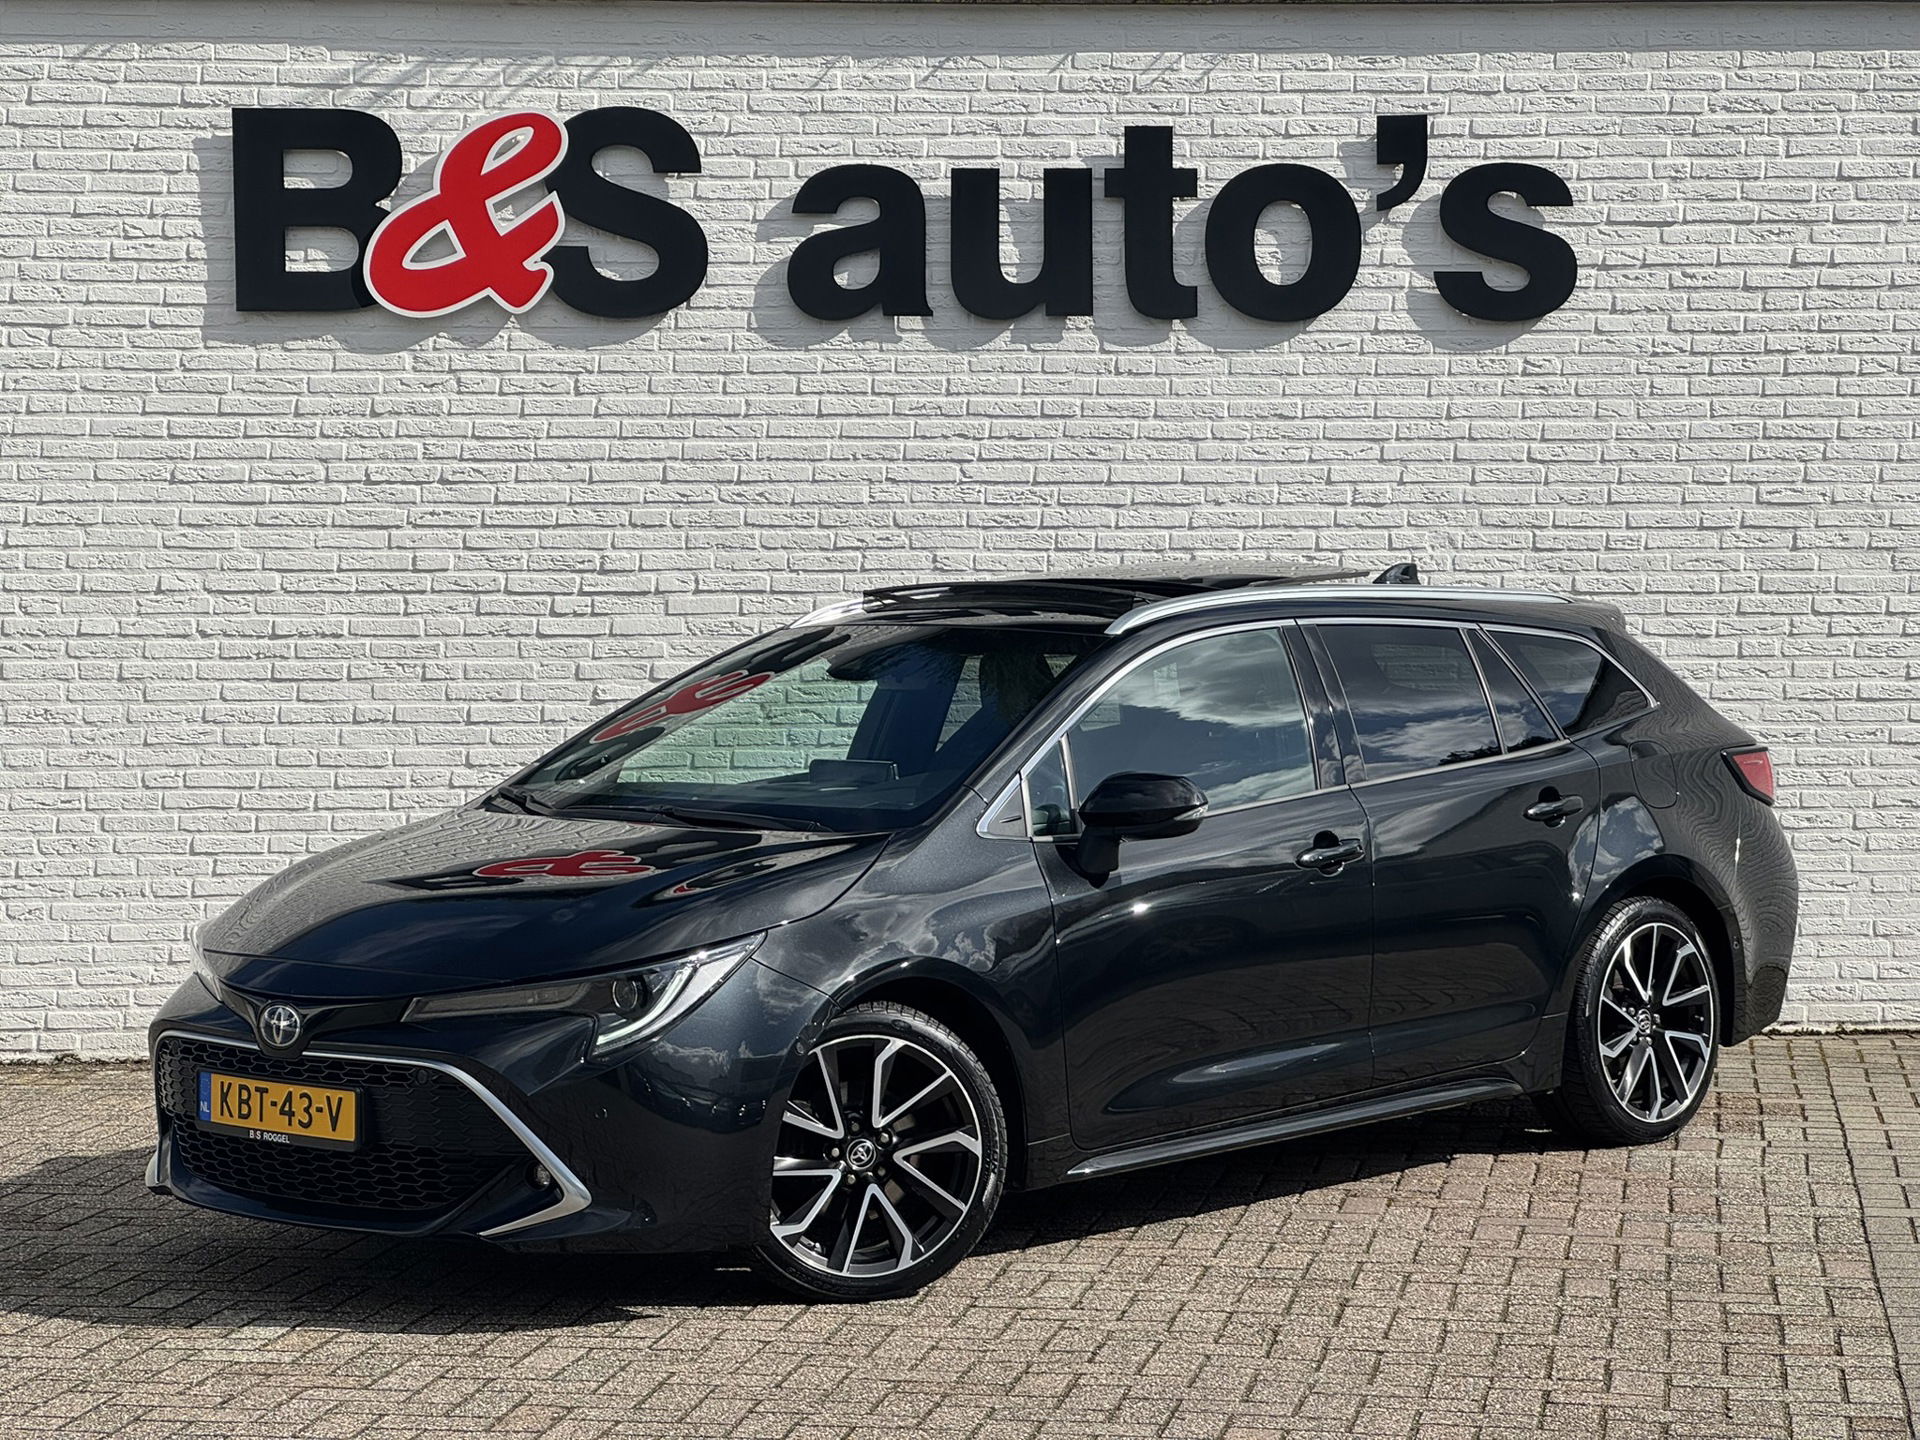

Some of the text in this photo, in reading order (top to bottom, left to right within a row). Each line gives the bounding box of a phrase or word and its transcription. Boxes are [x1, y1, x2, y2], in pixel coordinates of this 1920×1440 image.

[232, 106, 1578, 323] B&S auto's
[200, 1101, 210, 1113] NL
[220, 1081, 343, 1132] KBT-43-V
[263, 1132, 290, 1143] ROGGEL
